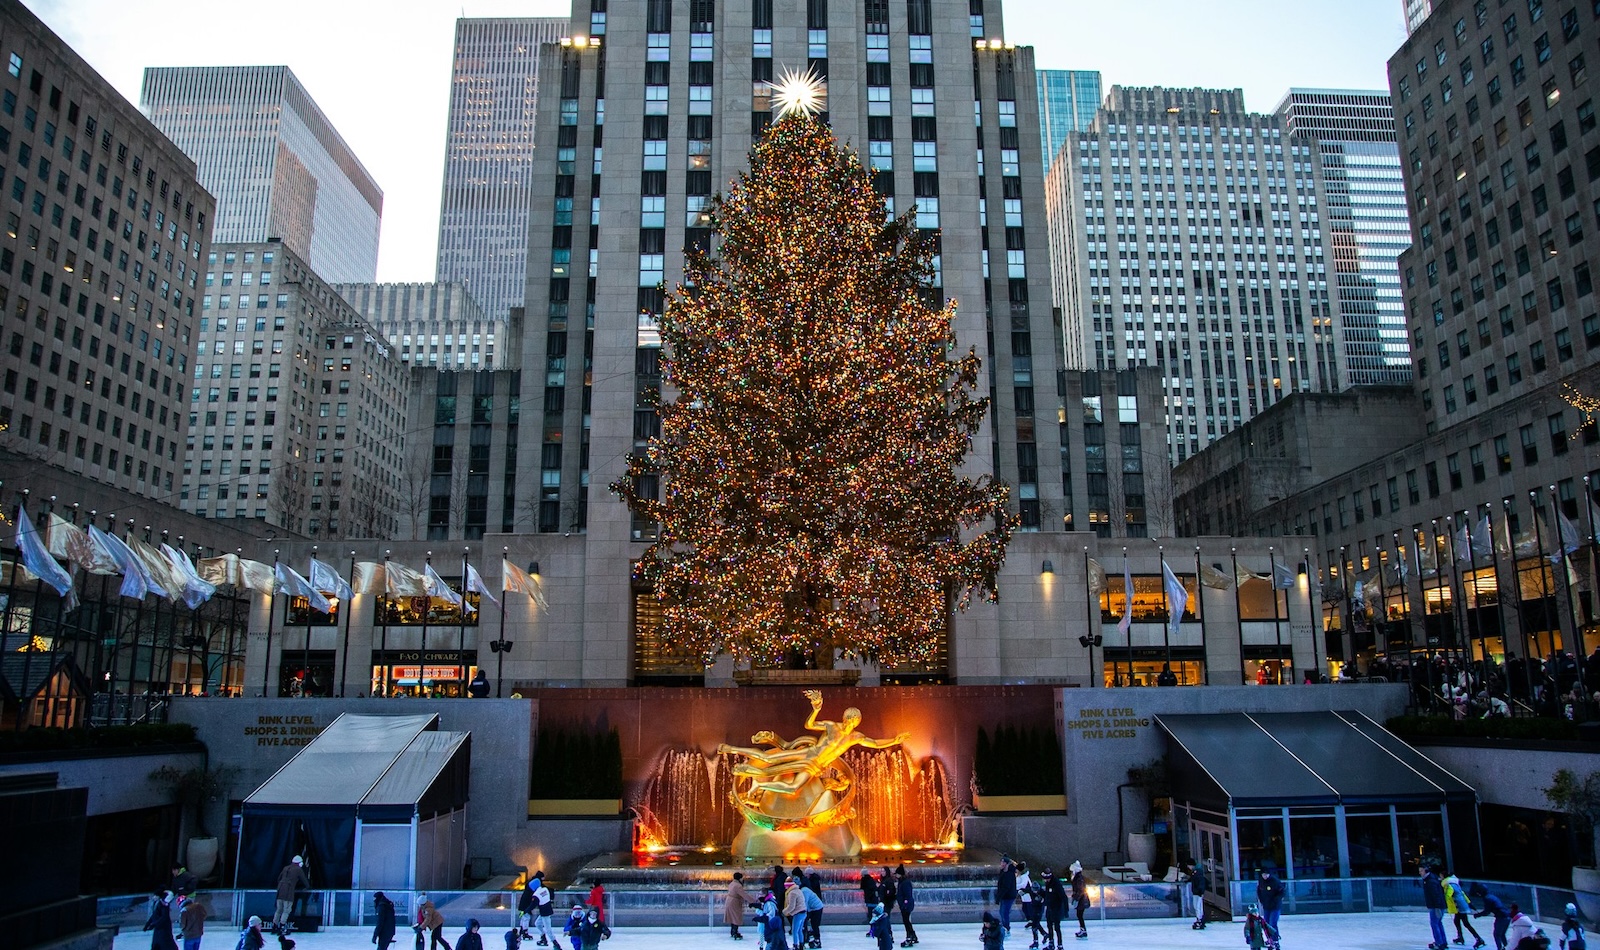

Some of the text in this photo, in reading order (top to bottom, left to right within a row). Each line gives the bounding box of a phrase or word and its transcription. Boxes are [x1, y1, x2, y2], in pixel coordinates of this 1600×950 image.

[1080, 708, 1136, 718] RINK LEVEL
[258, 715, 314, 724] RINK LEVEL
[1068, 718, 1149, 729] SHOPS & DINING
[244, 726, 278, 735] SHOPS
[280, 726, 287, 735] &
[1082, 729, 1136, 739] FIVE ACRES
[257, 737, 279, 746] FIVE
